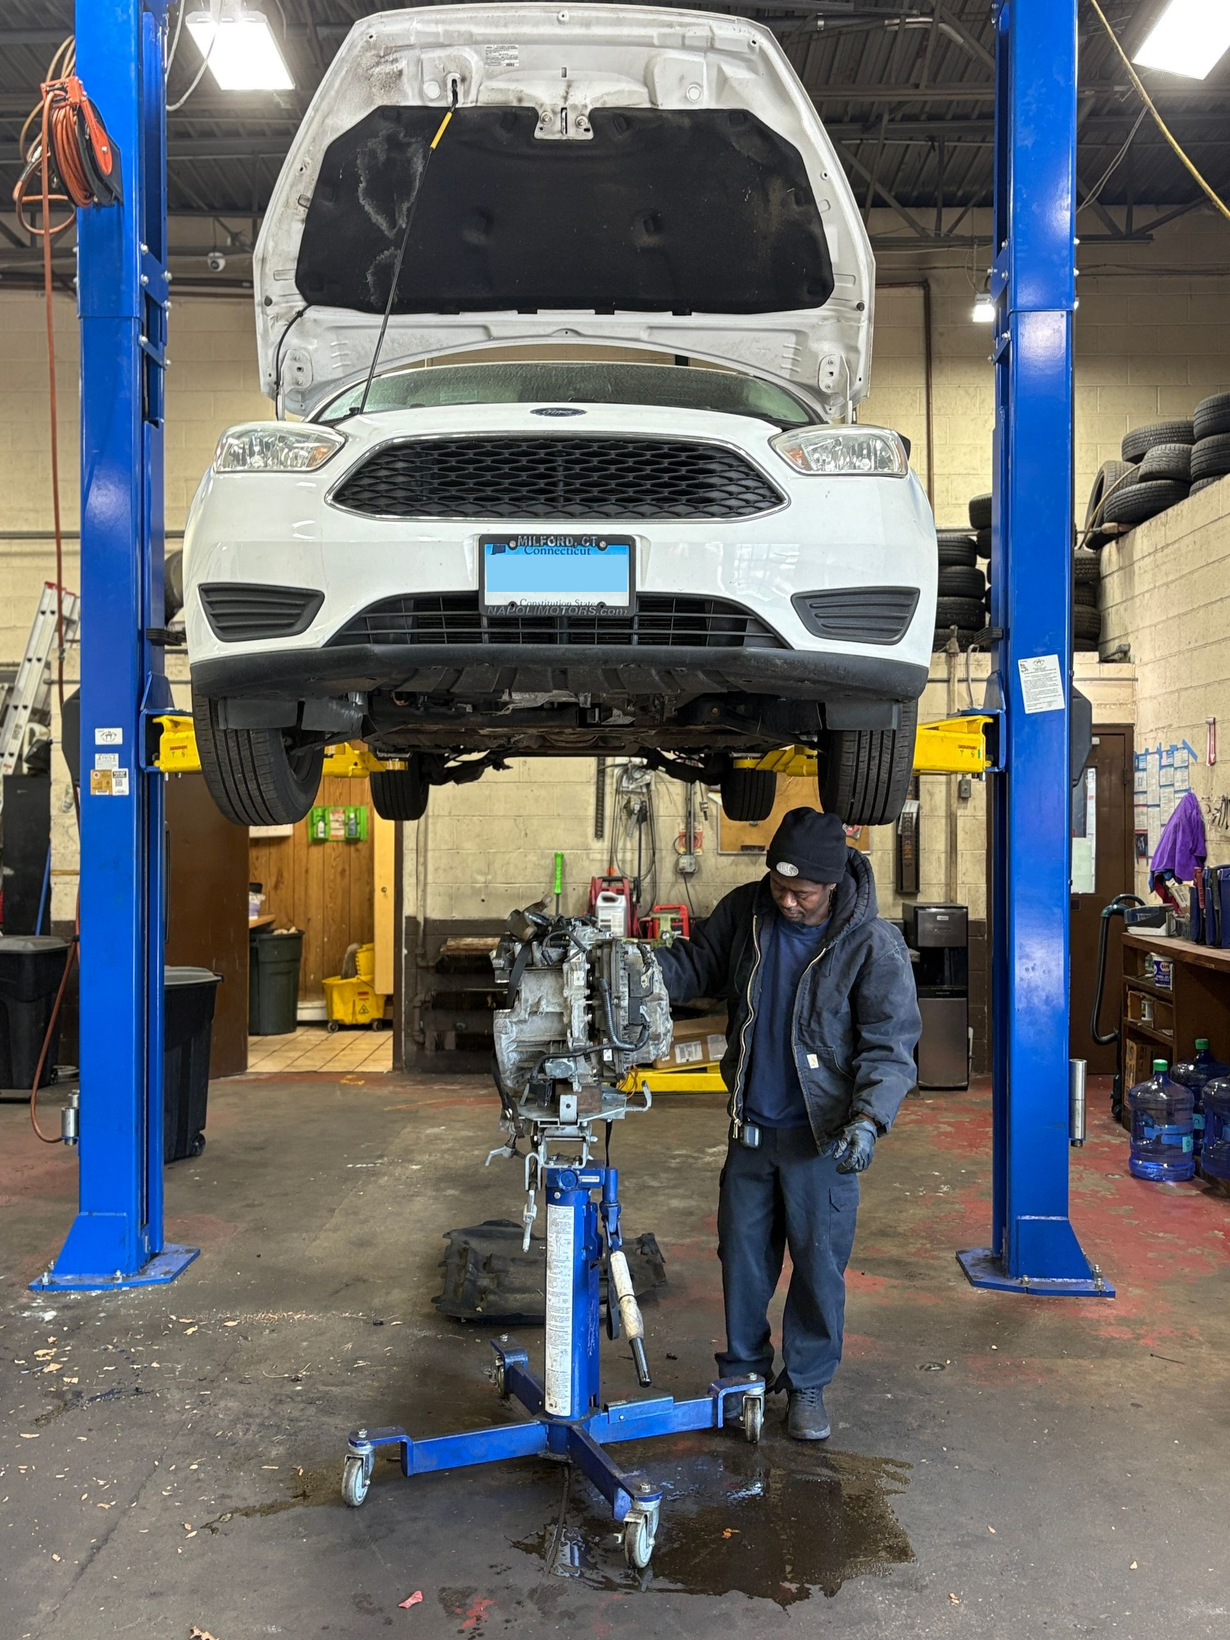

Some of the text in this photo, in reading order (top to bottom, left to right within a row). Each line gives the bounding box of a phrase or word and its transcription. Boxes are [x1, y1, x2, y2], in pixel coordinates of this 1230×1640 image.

[517, 535, 598, 548] MILFORD, CT
[524, 545, 591, 556] Connecticut
[520, 598, 572, 606] Constitution
[487, 605, 628, 617] NAPOLIMOTORS.com
